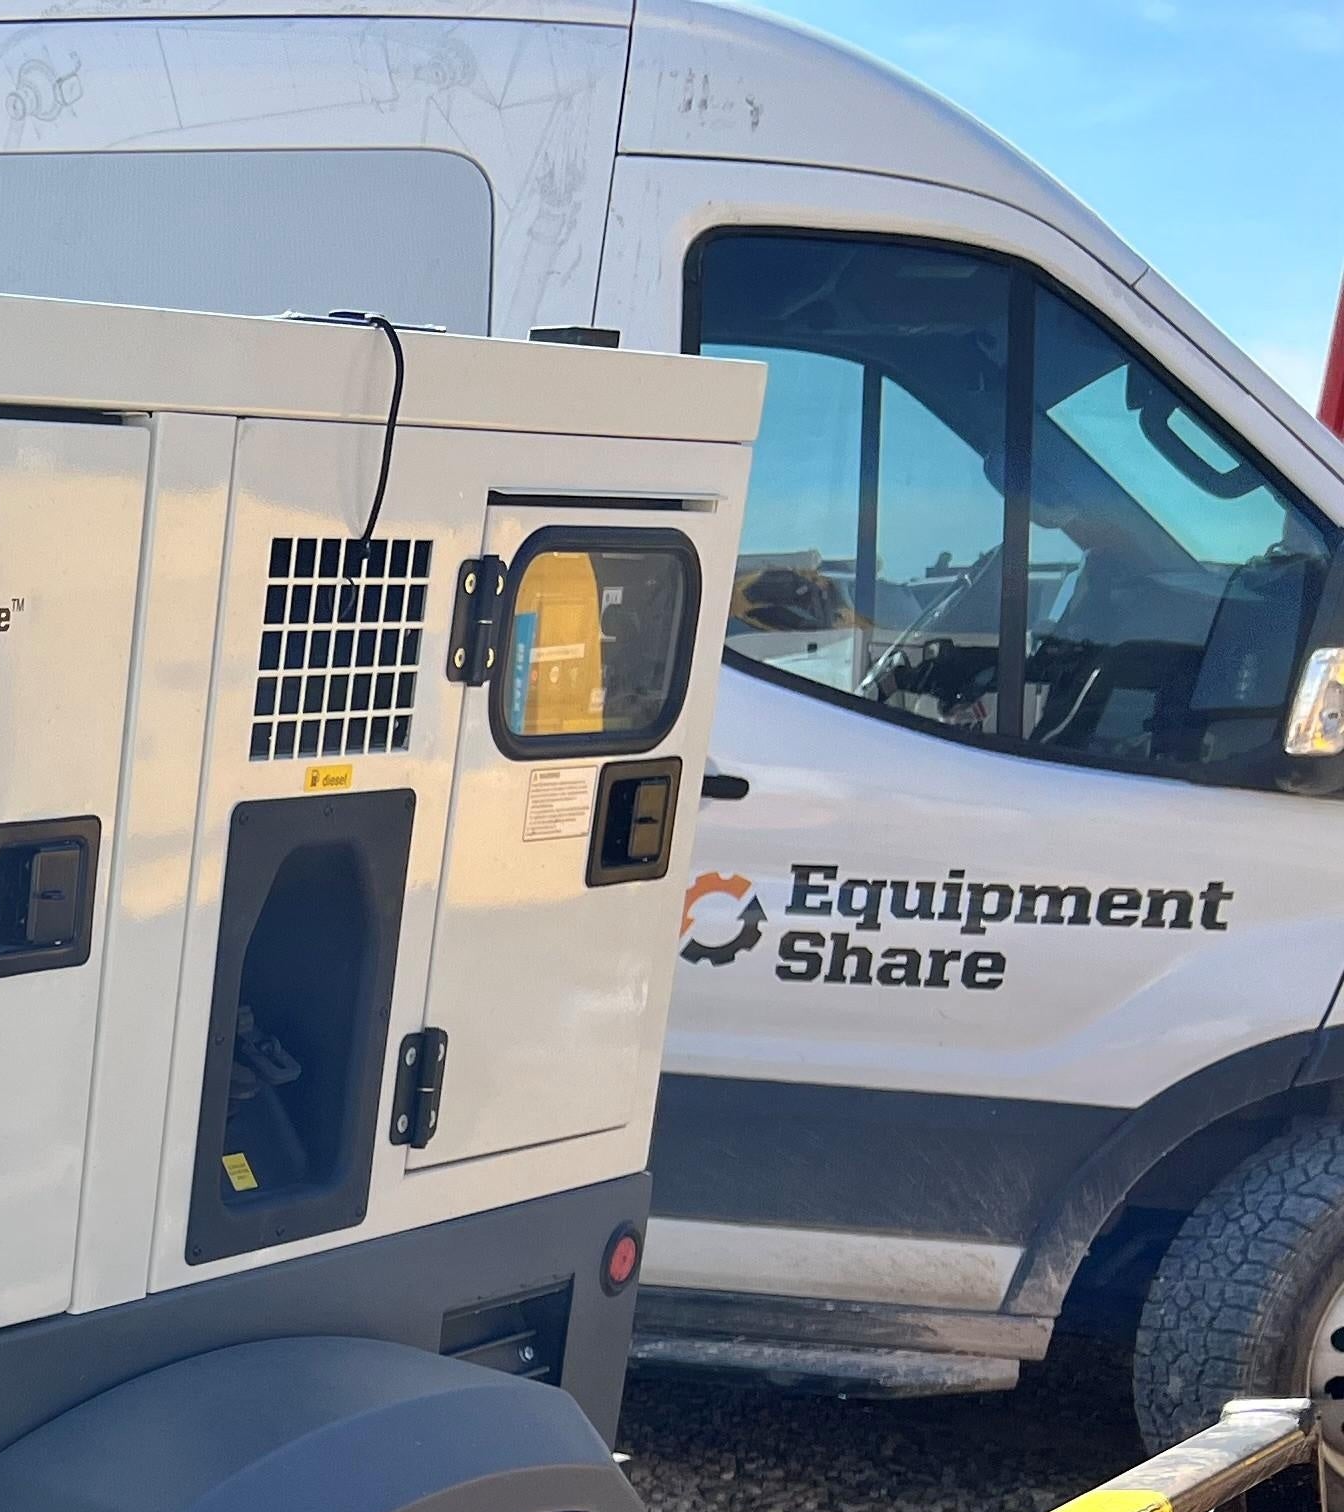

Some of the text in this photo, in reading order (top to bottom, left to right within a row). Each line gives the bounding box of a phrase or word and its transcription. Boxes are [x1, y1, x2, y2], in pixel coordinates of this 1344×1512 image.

[322, 774, 348, 787] diesel
[784, 863, 1236, 936] Equipment
[774, 929, 1007, 991] Share
